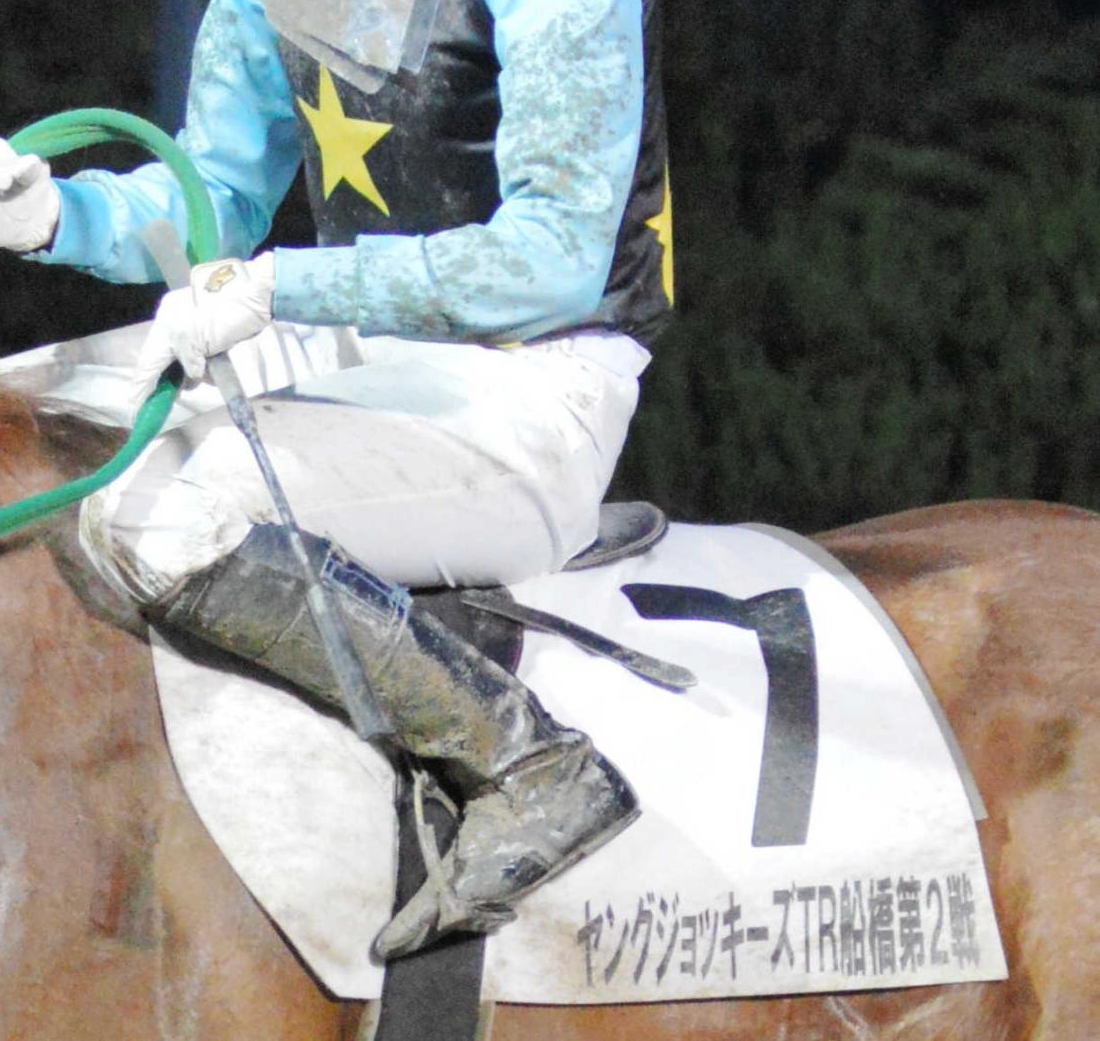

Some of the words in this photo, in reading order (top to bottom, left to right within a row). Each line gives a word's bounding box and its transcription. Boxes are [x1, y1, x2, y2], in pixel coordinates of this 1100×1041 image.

[620, 583, 819, 847] 7
[577, 872, 979, 986] ヤングジョッキーズTR船橋第2戦
